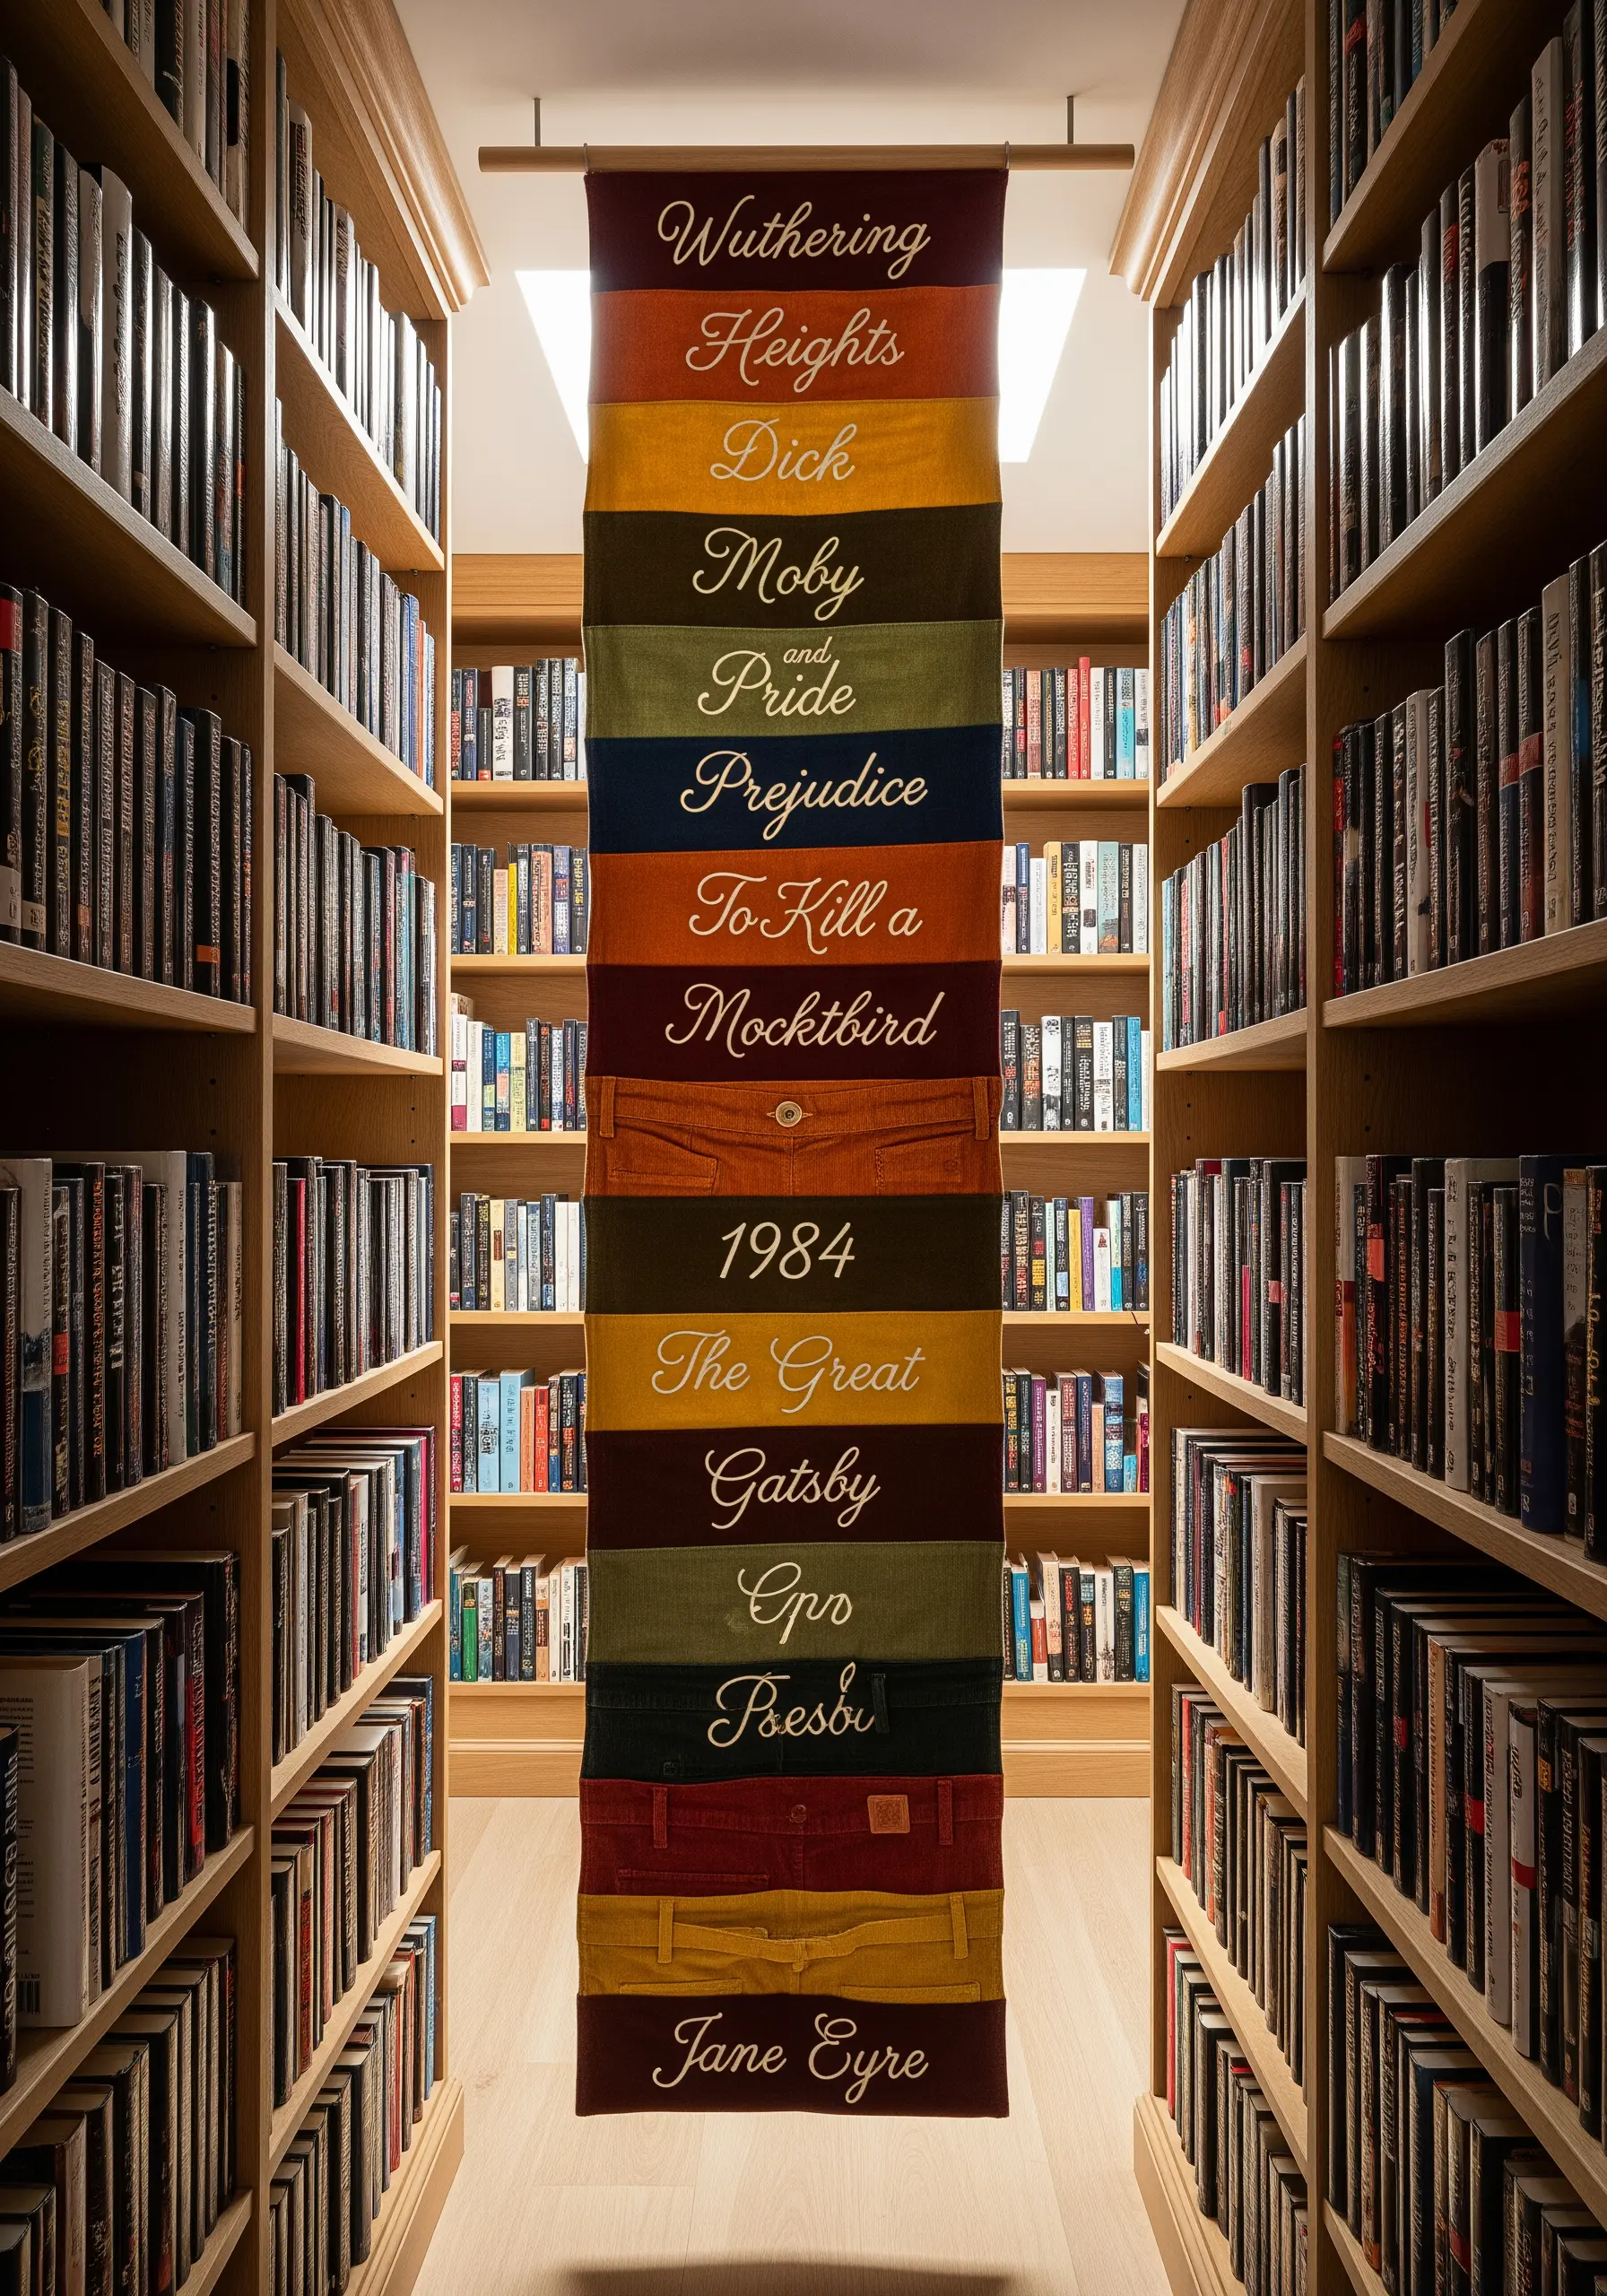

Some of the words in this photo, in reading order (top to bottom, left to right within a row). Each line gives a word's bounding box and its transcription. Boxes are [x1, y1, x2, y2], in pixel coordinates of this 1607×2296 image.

[657, 195, 932, 279] Wuthering
[685, 307, 905, 393] Heights
[709, 418, 857, 482] Dick
[692, 526, 865, 622] Moby
[697, 649, 856, 717] Pride
[783, 636, 833, 664] and
[680, 750, 928, 840] Prejudice
[688, 872, 768, 937] To
[759, 877, 888, 955] Kill
[888, 905, 924, 936] a
[665, 983, 945, 1058] Mocktbird
[719, 1222, 856, 1280] 1984
[651, 1329, 751, 1395] The
[769, 1335, 926, 1414] Great
[704, 1446, 882, 1530] Gatsby
[652, 2012, 787, 2088] Jane
[808, 2013, 929, 2104] Eyre
